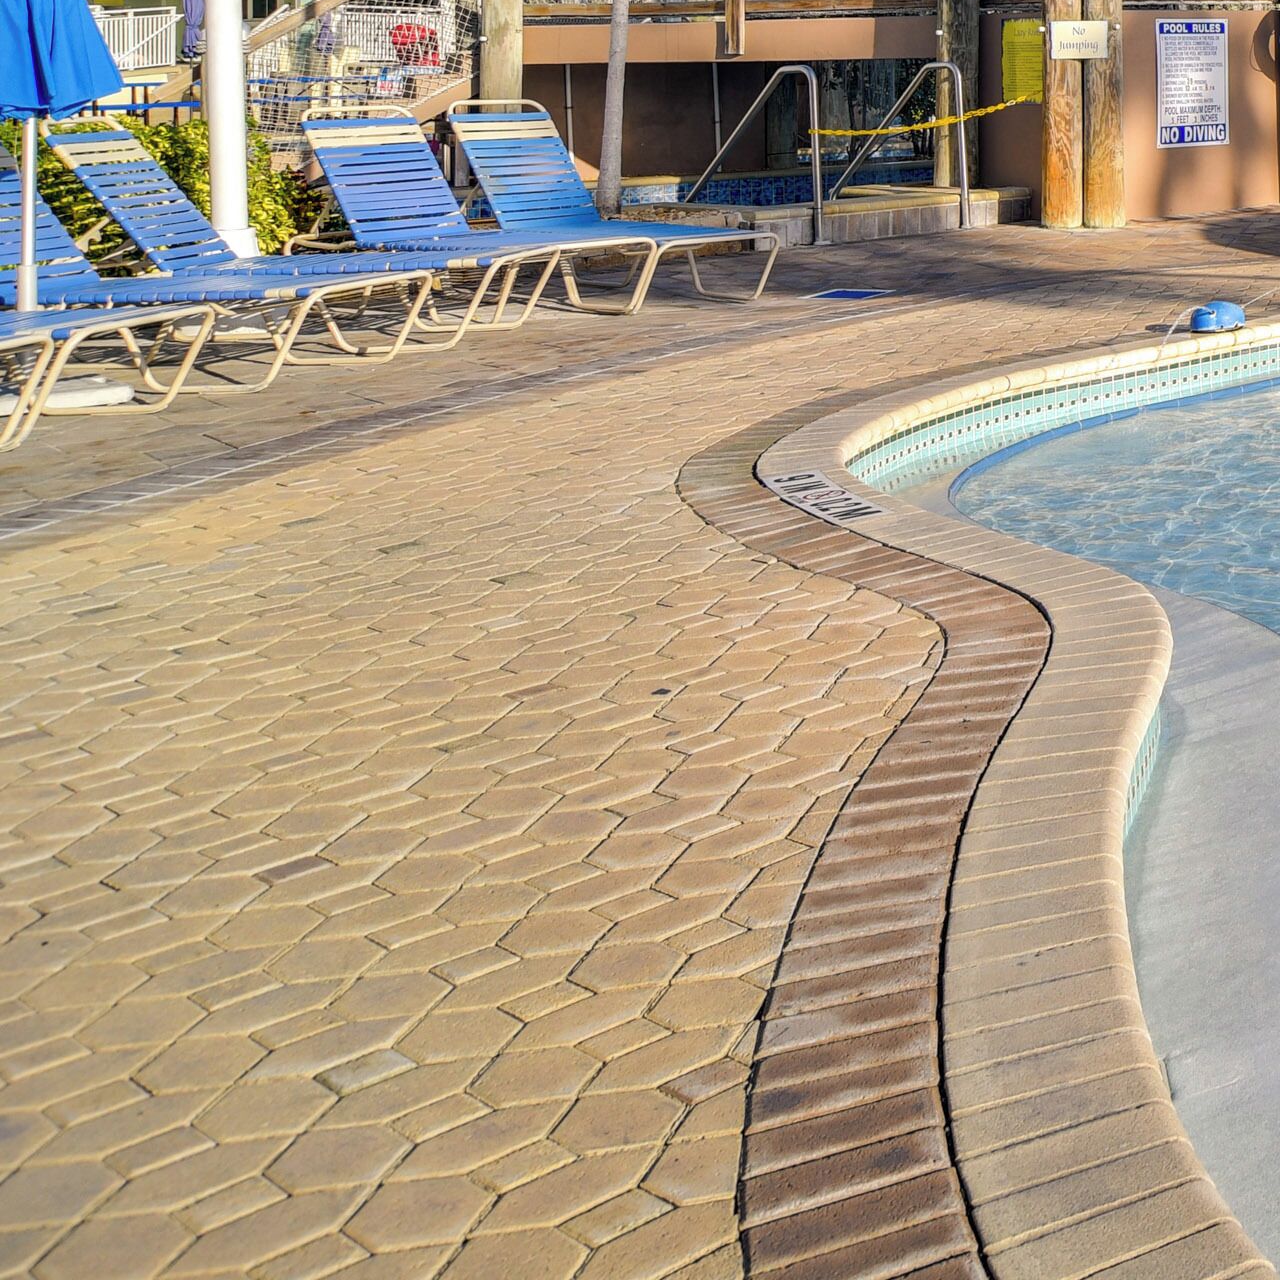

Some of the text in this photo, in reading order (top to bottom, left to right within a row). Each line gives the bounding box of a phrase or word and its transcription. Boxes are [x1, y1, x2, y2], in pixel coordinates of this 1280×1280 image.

[1072, 26, 1086, 36] No
[1163, 23, 1221, 33] POOL RULES
[1165, 106, 1179, 115] POOL
[1180, 105, 1203, 114] MAXIMUM
[1177, 115, 1189, 124] FEET
[1200, 113, 1218, 123] INCHES
[1161, 124, 1225, 143] NO DIVING
